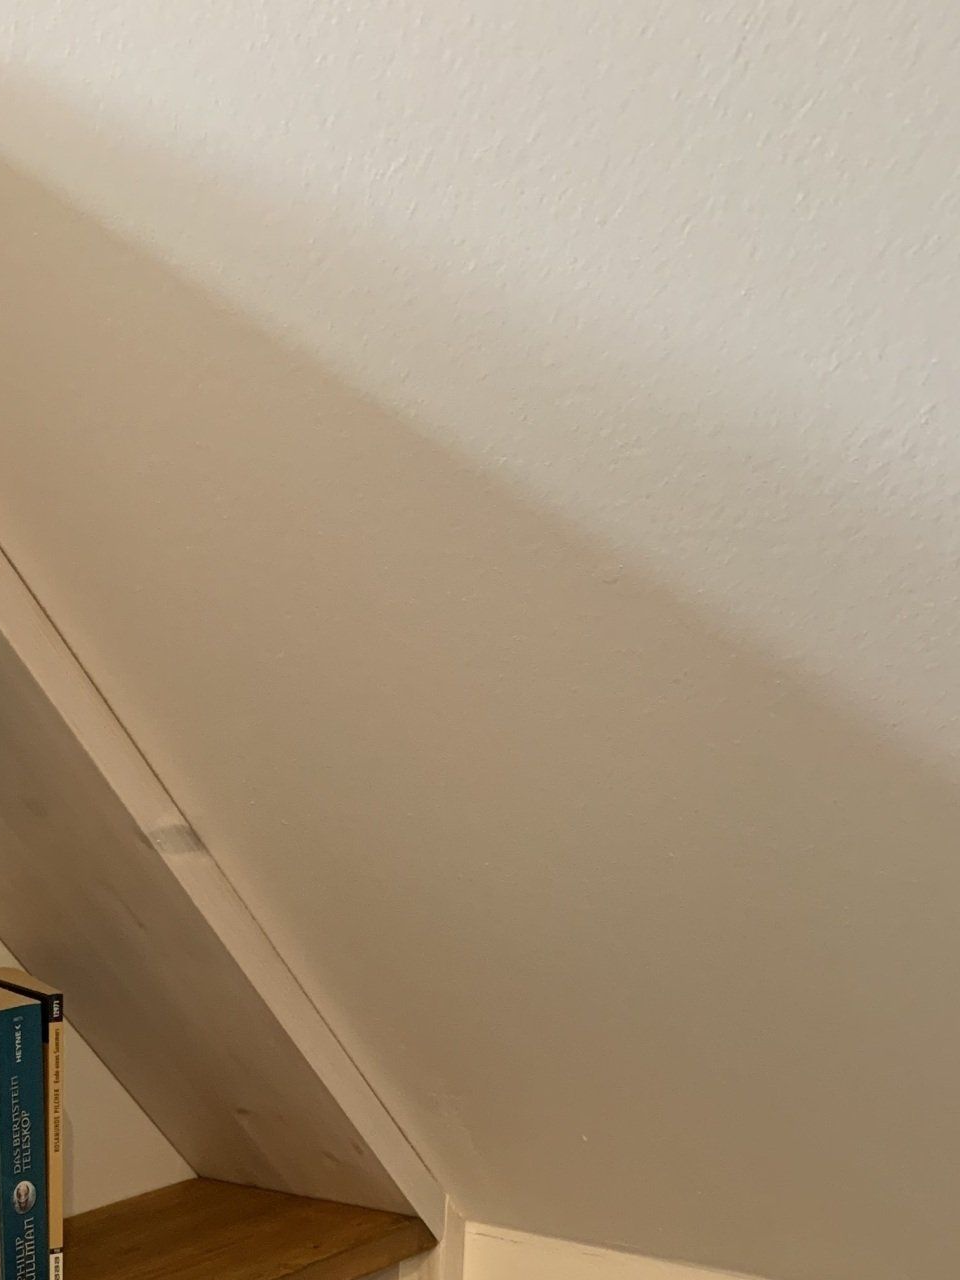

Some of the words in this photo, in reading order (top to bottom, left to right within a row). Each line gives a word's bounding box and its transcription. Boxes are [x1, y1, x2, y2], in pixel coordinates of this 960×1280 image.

[10, 1076, 21, 1149] BERNSTEIN
[21, 1111, 32, 1172] TELESKOP
[13, 1150, 22, 1174] DAS
